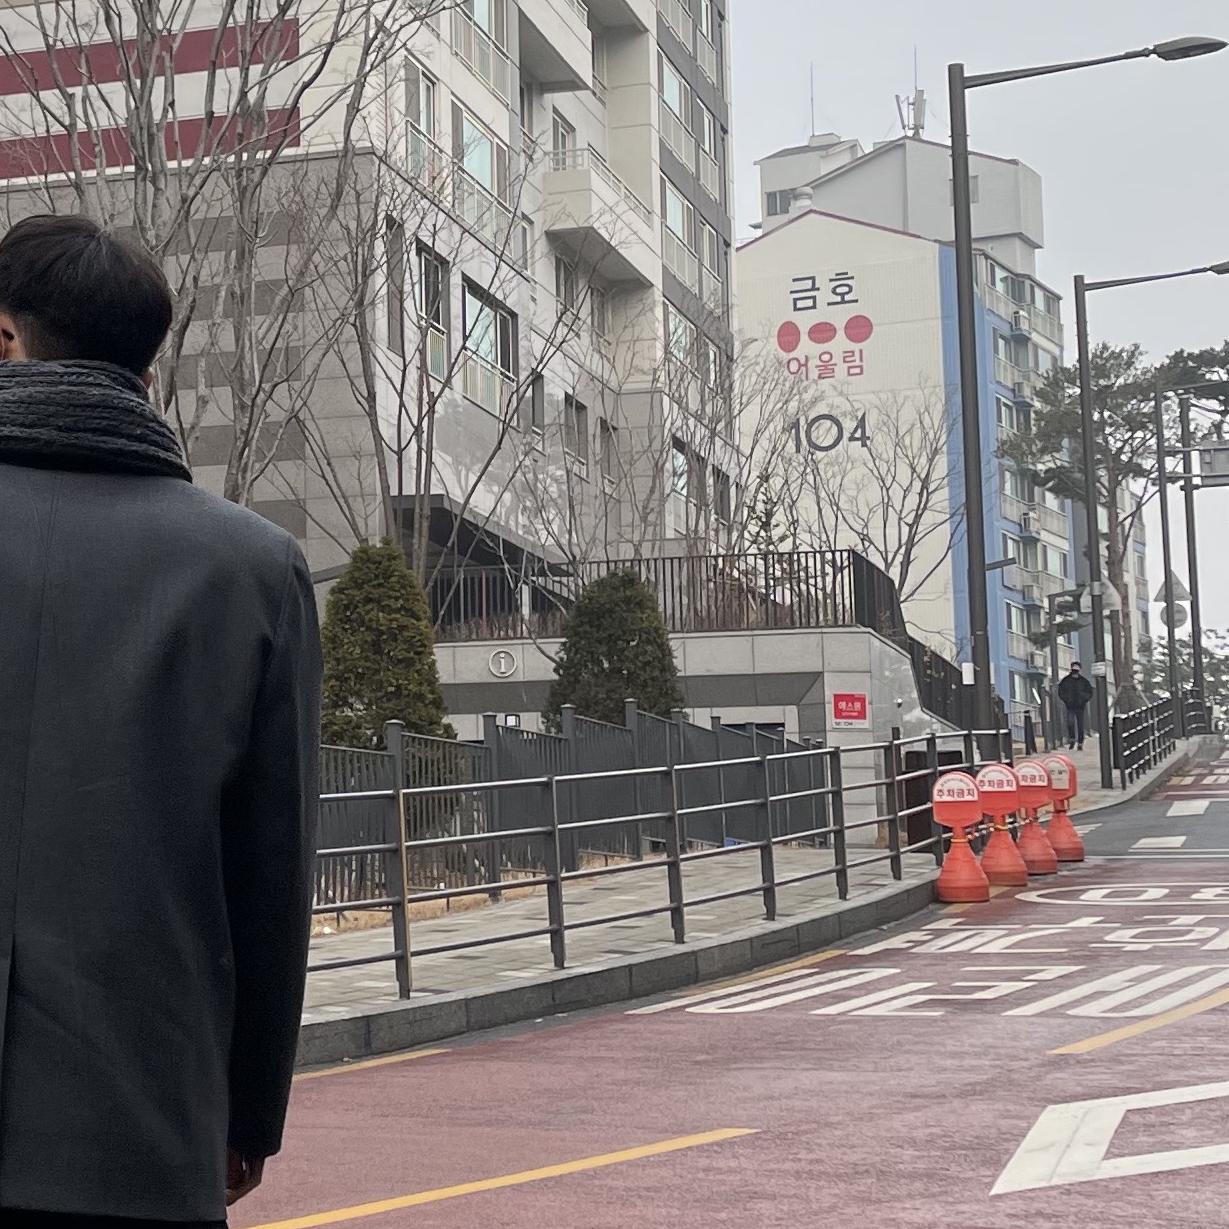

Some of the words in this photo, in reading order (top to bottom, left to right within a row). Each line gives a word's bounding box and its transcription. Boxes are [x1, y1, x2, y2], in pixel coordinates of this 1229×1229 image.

[789, 271, 859, 312] 금호
[786, 349, 865, 381] 어울림
[790, 411, 871, 454] 104
[936, 788, 976, 799] 주차금지
[978, 779, 1014, 789] 주차금지
[1020, 774, 1046, 783] 차금지
[623, 964, 1229, 1017] 어린이
